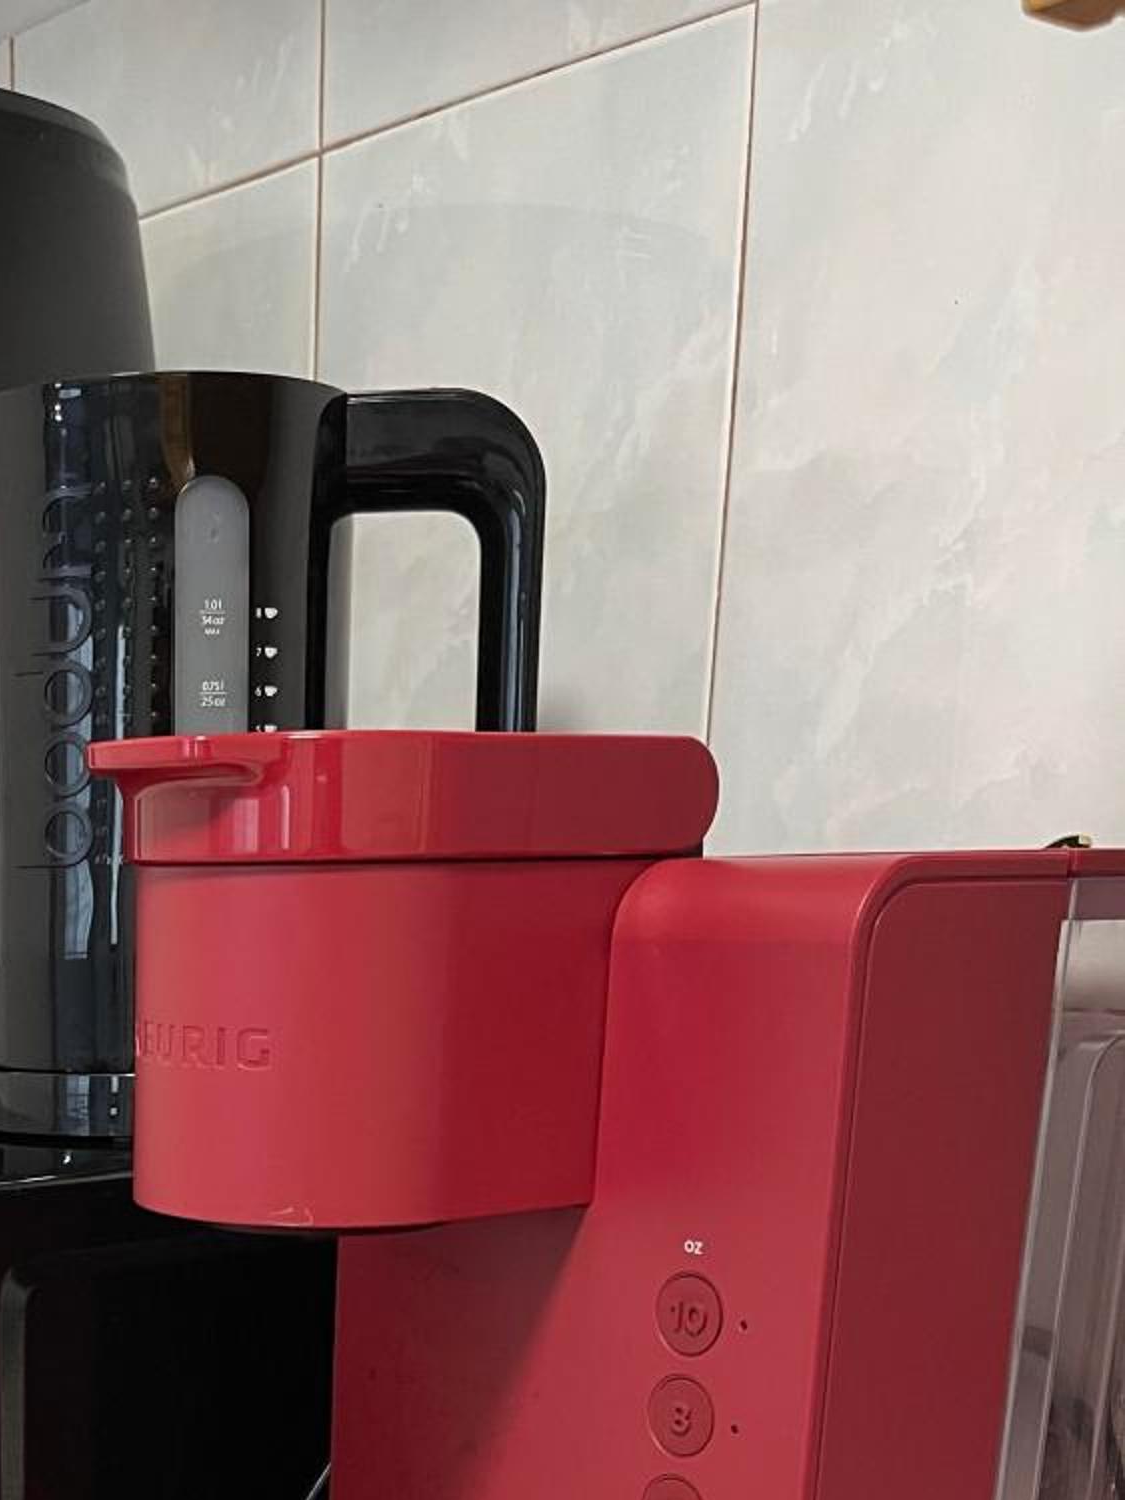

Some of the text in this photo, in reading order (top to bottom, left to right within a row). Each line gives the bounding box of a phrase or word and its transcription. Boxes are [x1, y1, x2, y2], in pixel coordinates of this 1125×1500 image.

[13, 491, 93, 869] bodum
[136, 1023, 271, 1070] EURIG
[683, 1240, 703, 1255] OZ
[669, 1301, 709, 1338] 10
